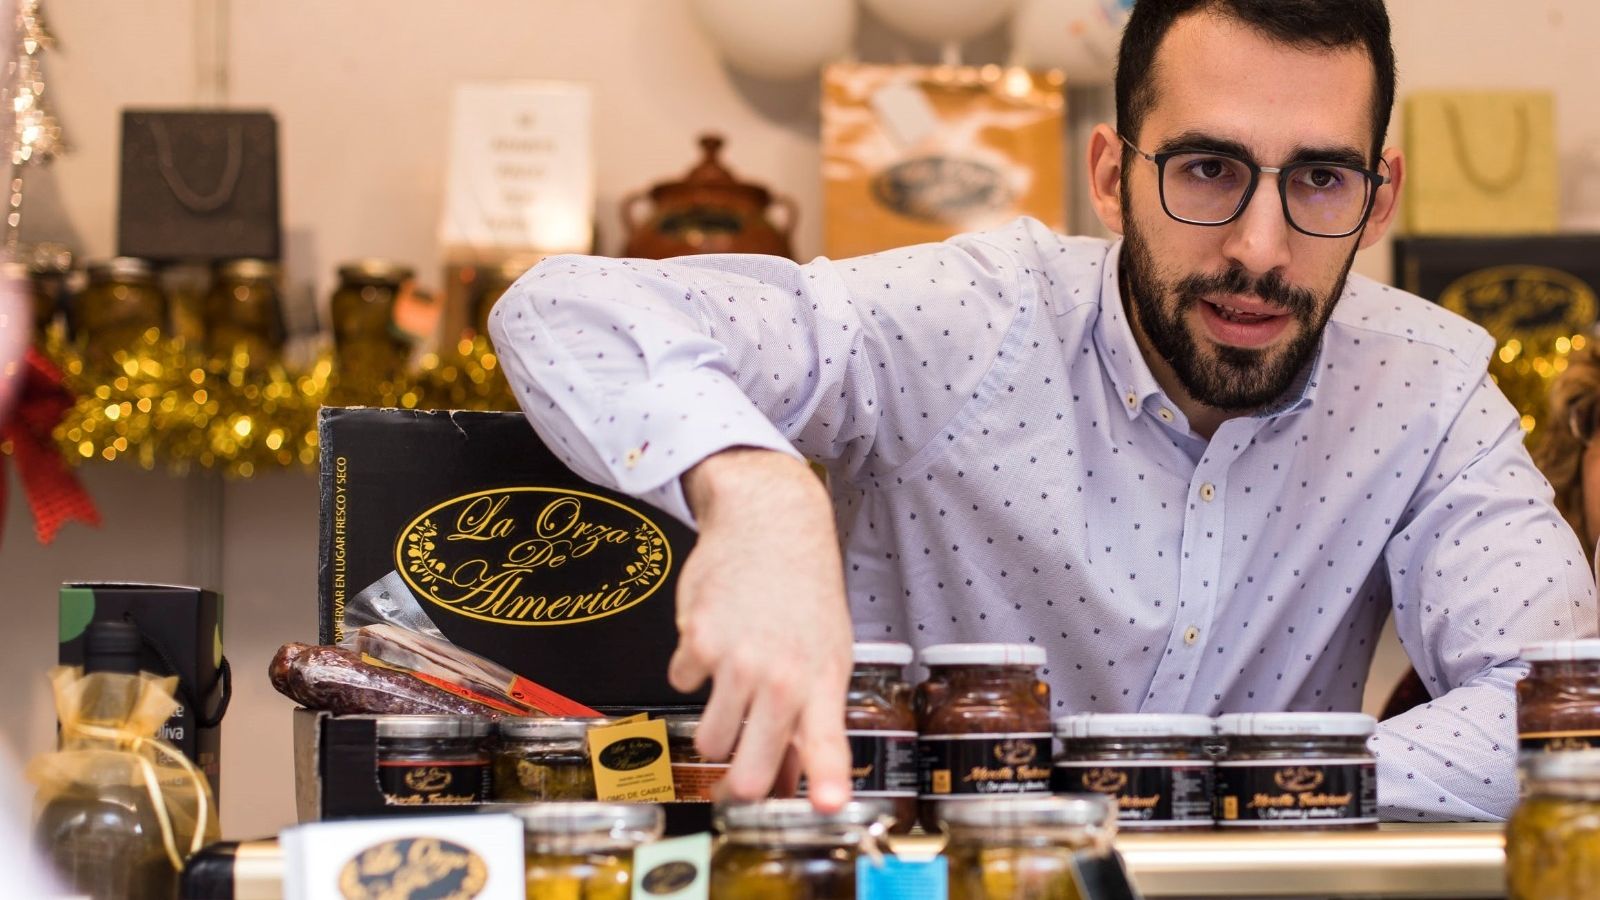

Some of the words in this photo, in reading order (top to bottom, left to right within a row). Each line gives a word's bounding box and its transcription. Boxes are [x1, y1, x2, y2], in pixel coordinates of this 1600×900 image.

[336, 457, 347, 483] SECO
[335, 483, 347, 494] Y
[335, 495, 346, 535] FRESCO
[447, 495, 515, 540] La
[536, 496, 630, 558] Orza
[335, 537, 346, 571] LUGAR
[502, 538, 572, 567] De
[335, 573, 346, 588] EN
[627, 791, 638, 799] DE
[640, 785, 672, 796] CABEZA
